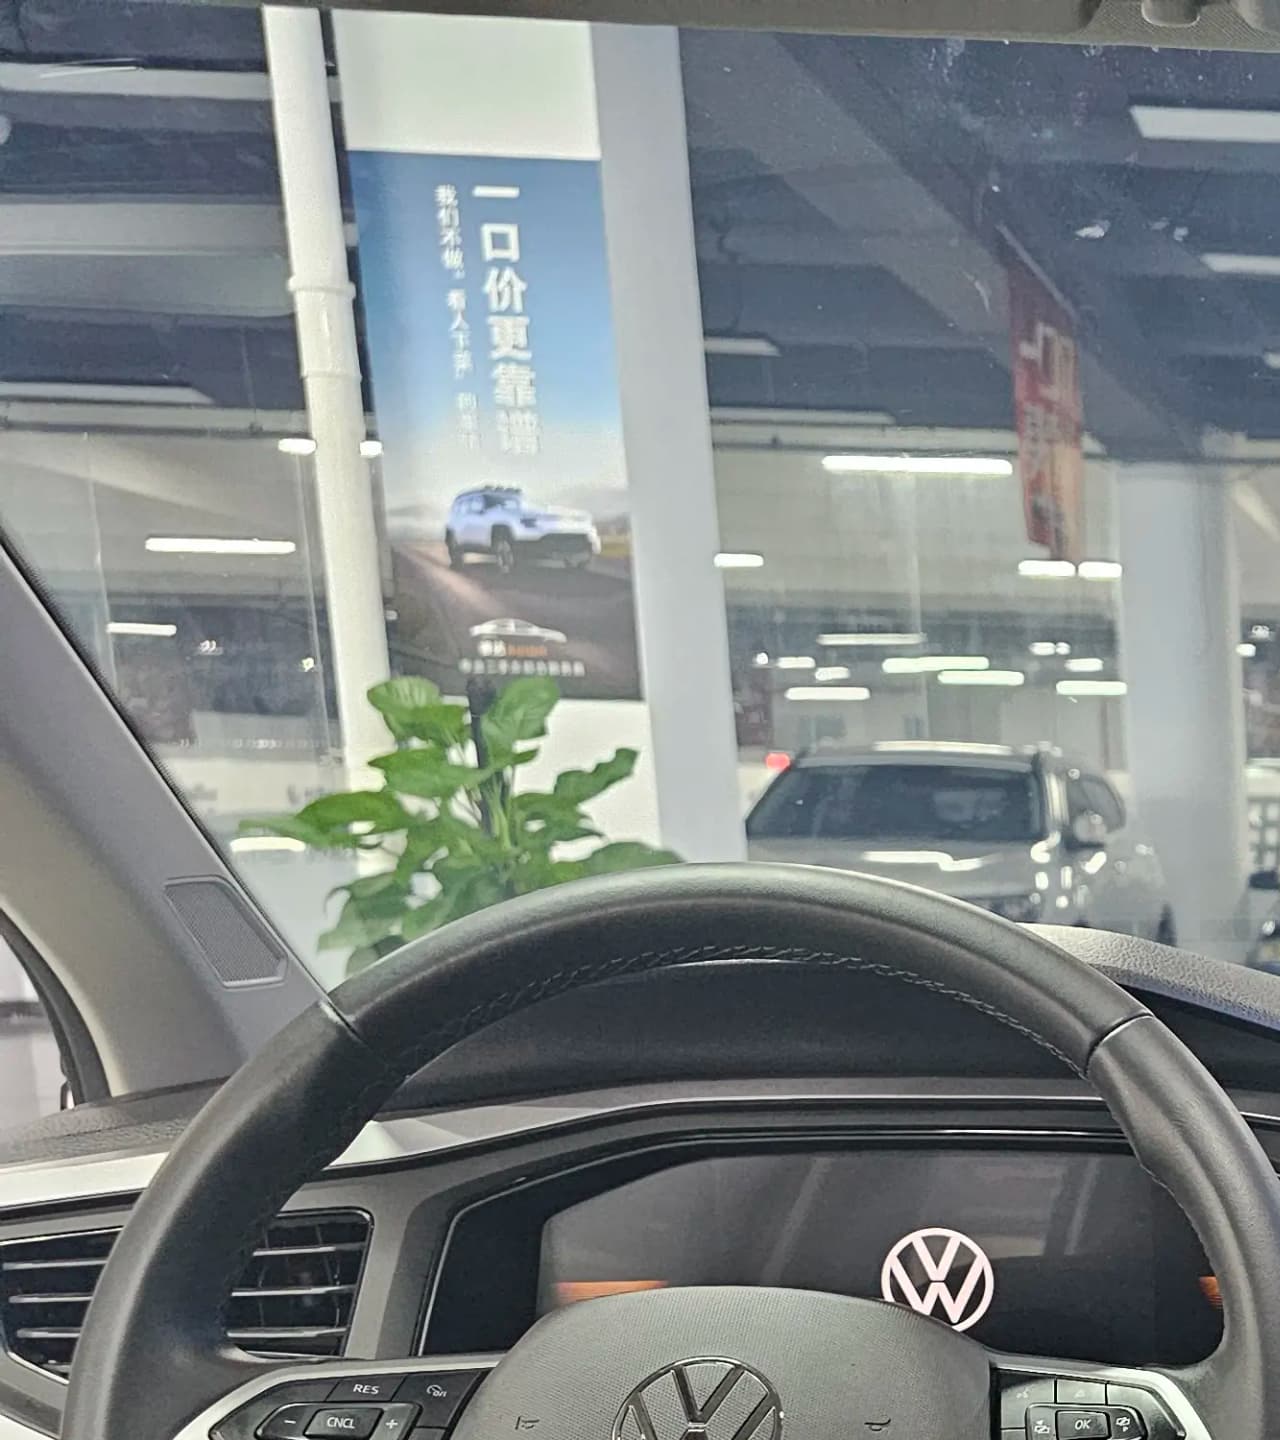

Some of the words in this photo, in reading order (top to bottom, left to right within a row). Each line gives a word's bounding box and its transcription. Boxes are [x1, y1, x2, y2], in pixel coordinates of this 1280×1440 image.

[472, 185, 543, 455] 一口价更靠谱
[353, 1383, 380, 1395] RES
[326, 1416, 356, 1429] CNCL
[1074, 1419, 1092, 1431] OK
